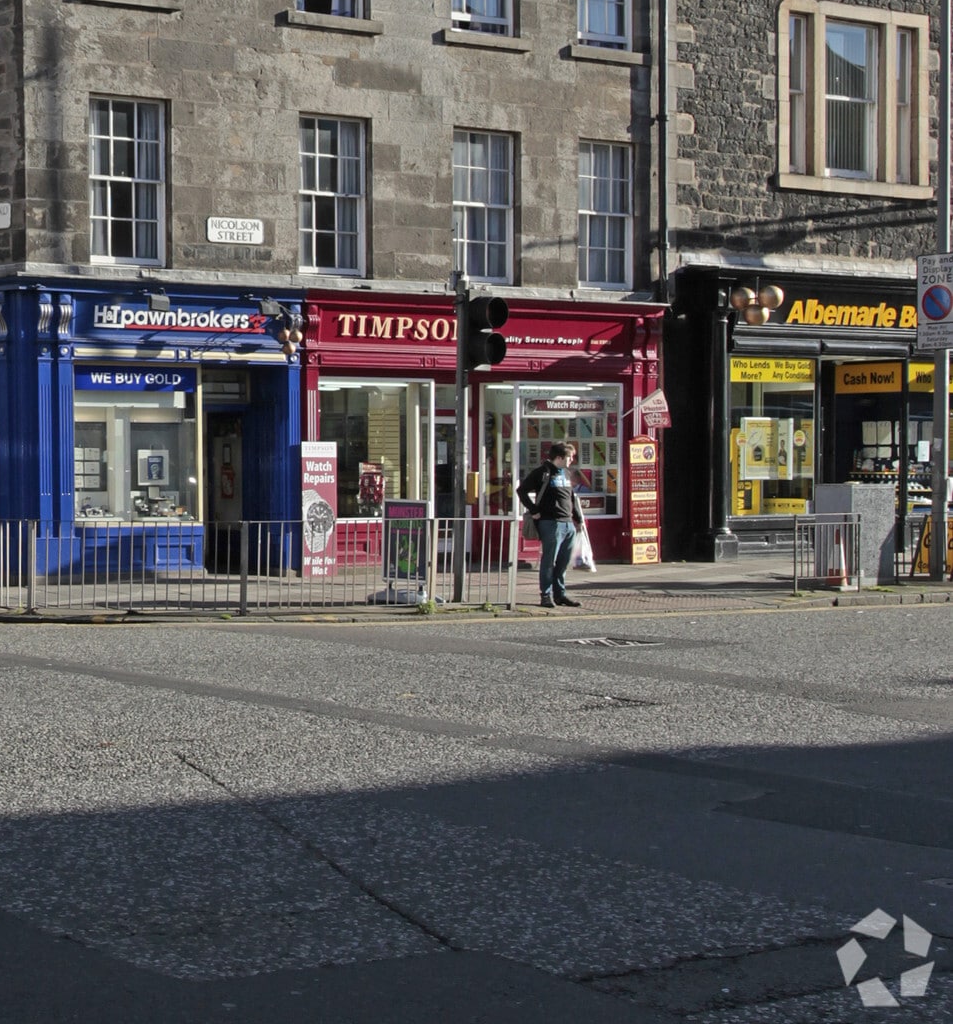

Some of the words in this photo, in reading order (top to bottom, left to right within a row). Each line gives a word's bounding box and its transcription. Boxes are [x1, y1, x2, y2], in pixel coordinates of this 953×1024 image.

[211, 219, 260, 231] NICOLSON
[217, 231, 254, 242] STREET
[922, 257, 936, 266] Pay
[923, 265, 952, 274] Display
[922, 273, 953, 284] ZONE
[786, 298, 897, 328] Albemarle
[338, 314, 457, 341] TIMPSO
[505, 336, 522, 344] ality
[525, 336, 555, 345] Service
[557, 336, 583, 346] People
[733, 360, 748, 368] Who
[750, 360, 770, 369] Lends
[785, 361, 796, 370] Buy
[797, 361, 811, 369] Gold
[91, 372, 112, 384] WE
[115, 373, 142, 385] BUY
[145, 373, 182, 385] GOLD
[740, 371, 762, 380] More?
[773, 371, 784, 380] Any
[785, 371, 812, 379] Condition
[843, 372, 867, 385] Cash
[870, 371, 895, 384] Now!
[546, 400, 569, 409] Watch
[569, 400, 596, 410] Repairs
[306, 461, 332, 472] Watch
[303, 473, 335, 485] Repairs
[312, 566, 327, 575] Wat
